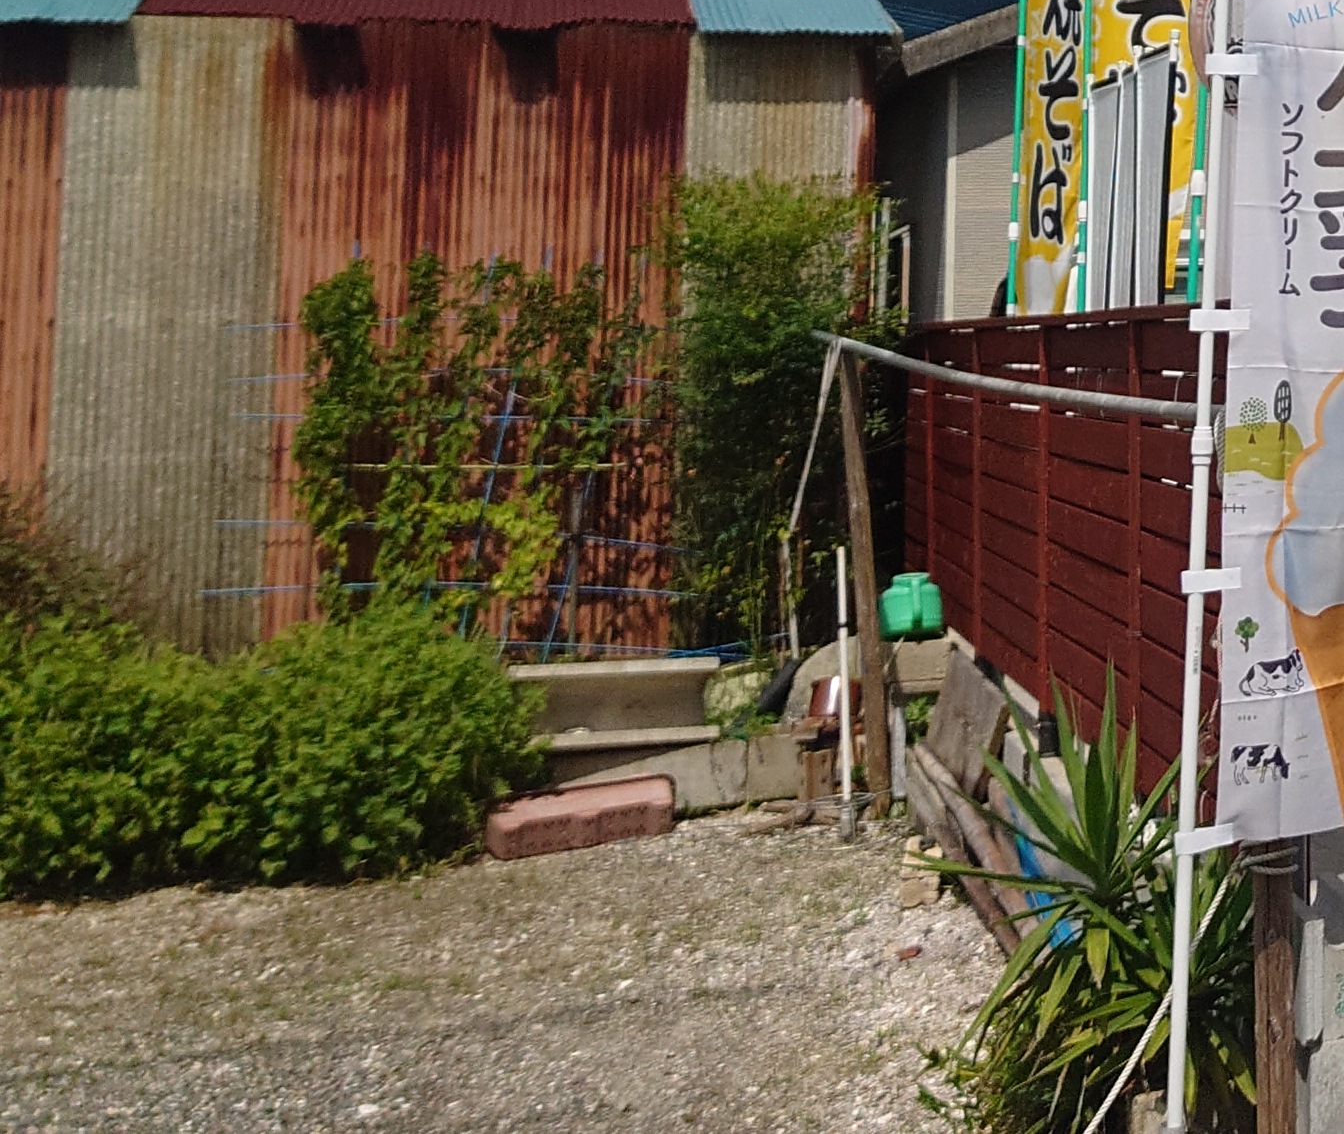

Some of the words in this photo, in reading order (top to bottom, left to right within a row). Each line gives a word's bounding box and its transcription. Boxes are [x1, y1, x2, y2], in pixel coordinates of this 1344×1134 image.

[1278, 103, 1304, 296] ソフトクリーム
